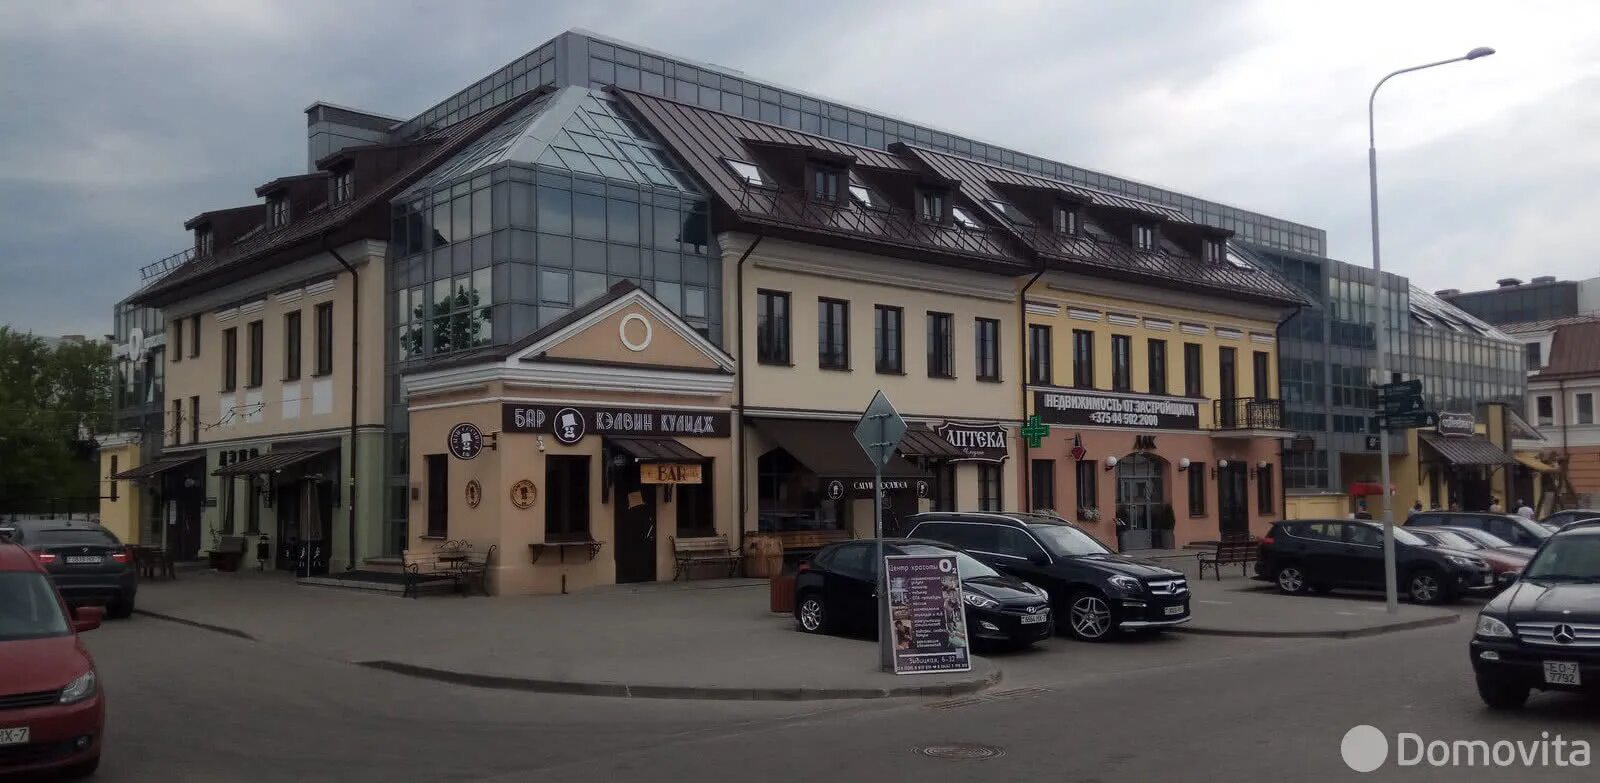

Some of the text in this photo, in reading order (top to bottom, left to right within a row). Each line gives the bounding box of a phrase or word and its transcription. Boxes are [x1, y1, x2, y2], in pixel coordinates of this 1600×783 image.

[1044, 394, 1195, 418] НЕДВИЖИМОСТЬ ОТ ЗАСТРОЙЩИКА
[514, 408, 715, 434] БАР КЭЛВИН КУЛИДЖ
[1089, 412, 1111, 424] +375
[1112, 413, 1122, 424] 44
[946, 430, 1006, 448] АПТЕКА
[658, 465, 686, 481] BAR
